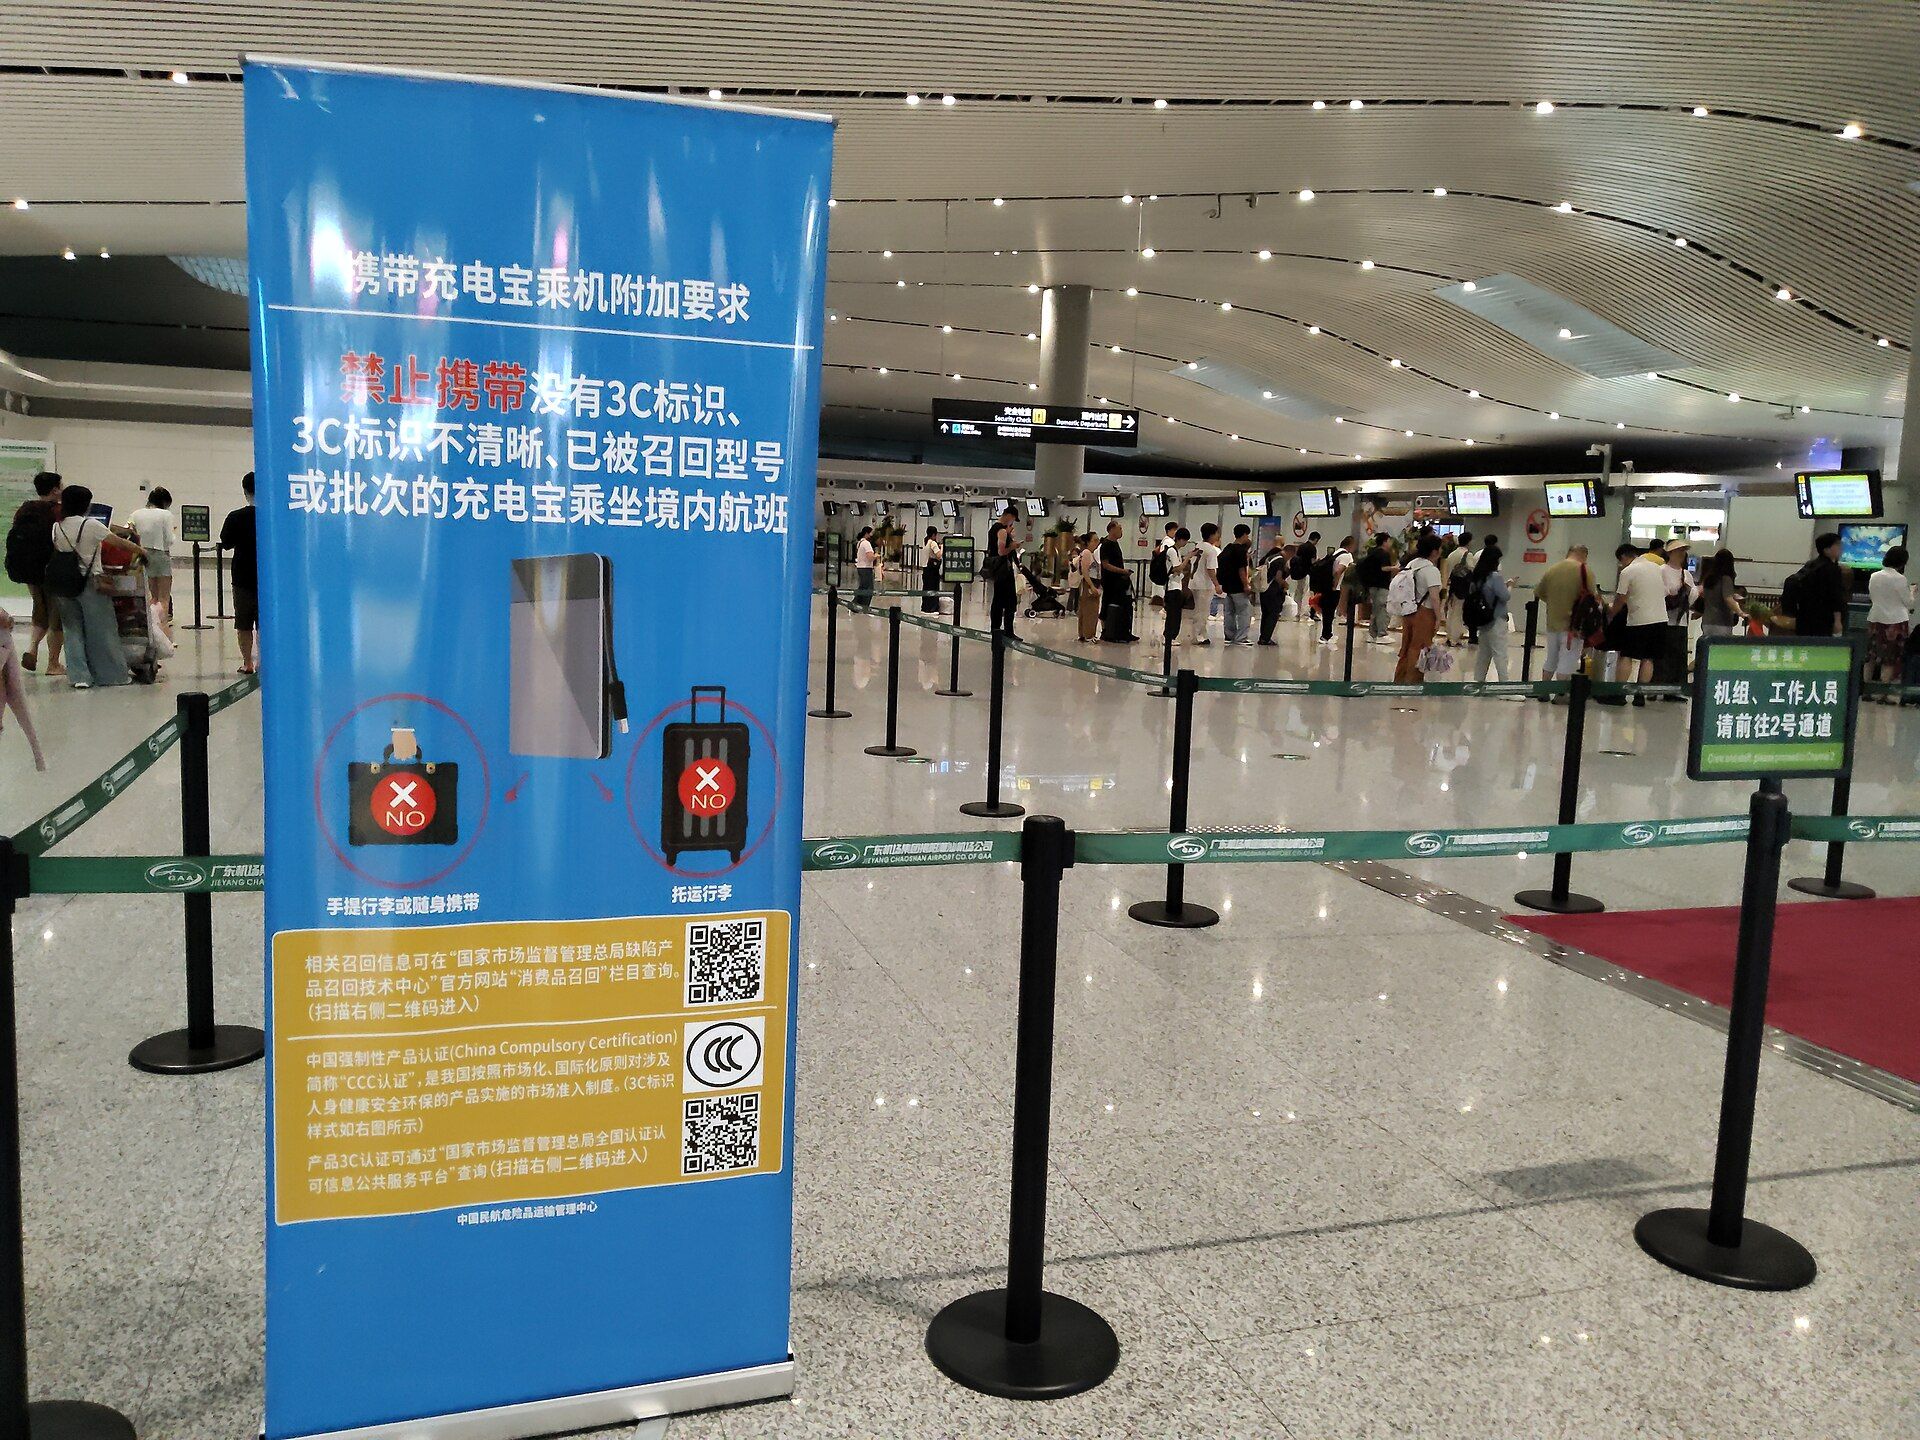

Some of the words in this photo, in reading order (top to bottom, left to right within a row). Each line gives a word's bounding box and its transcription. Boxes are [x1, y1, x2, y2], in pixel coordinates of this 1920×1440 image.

[348, 250, 751, 324] 携带充电宝乘机附加要求
[340, 351, 741, 428] 禁止携带没有3C标识、
[995, 415, 1015, 424] Security
[1056, 418, 1079, 426] Domestic
[1080, 420, 1108, 428] Departures
[291, 415, 784, 483] 3C标识不清晰、已被召回型号
[287, 471, 789, 534] 或批次的充电宝乘坐境内航班
[1588, 505, 1598, 515] 13
[1713, 679, 1838, 706] 机组、工作人员
[1716, 712, 1832, 739] 请前往2号通道
[691, 793, 726, 809] NO
[385, 810, 426, 827] NO
[211, 879, 245, 887] JIEYANG
[671, 884, 732, 903] 托运行李
[327, 892, 480, 916] 手提行李或随身携带
[308, 995, 480, 1021] （扫描右侧二维码进入）
[500, 1039, 586, 1056] Compulsory
[588, 1029, 678, 1049] Certification)
[307, 1116, 424, 1139] 样式如右图所示）
[456, 1200, 598, 1226] 中国民航危险品运输管理中心
